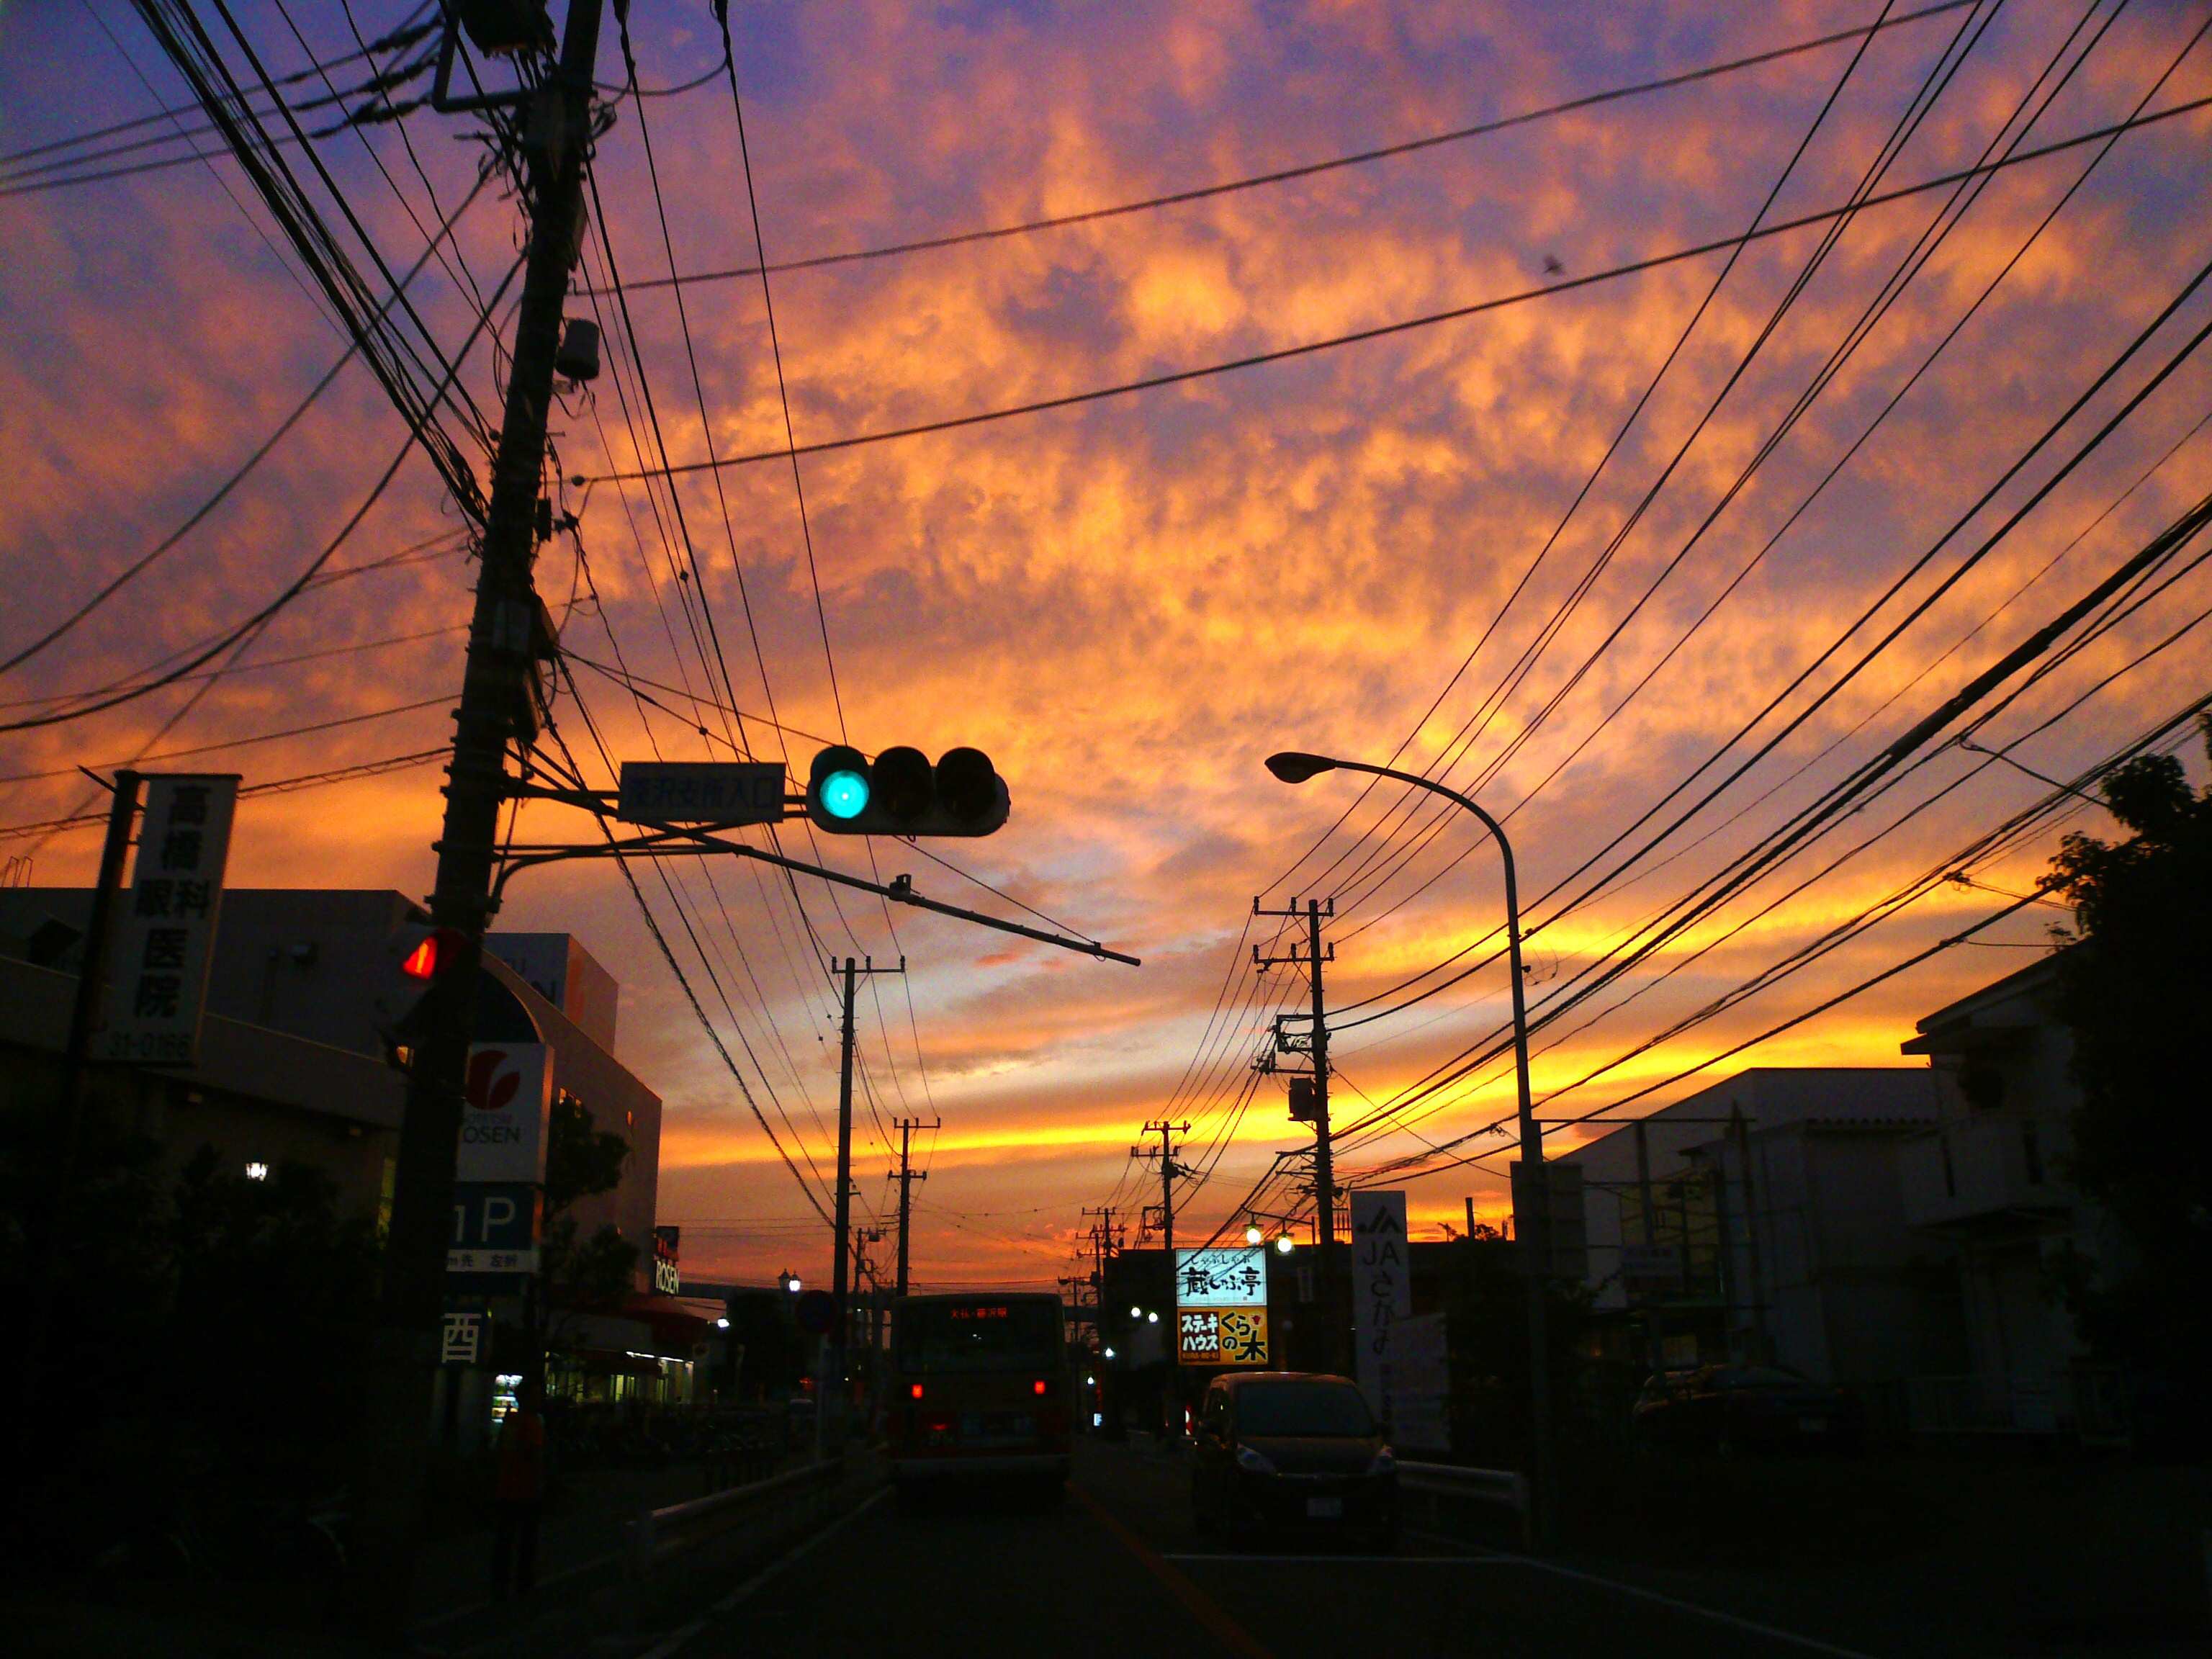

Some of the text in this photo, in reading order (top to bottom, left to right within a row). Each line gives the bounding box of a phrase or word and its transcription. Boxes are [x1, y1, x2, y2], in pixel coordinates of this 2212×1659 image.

[463, 1126, 521, 1144] OSEN
[656, 1260, 680, 1295] ROSEN
[1182, 1313, 1218, 1334] ステーキ
[1182, 1334, 1219, 1351] ハウス
